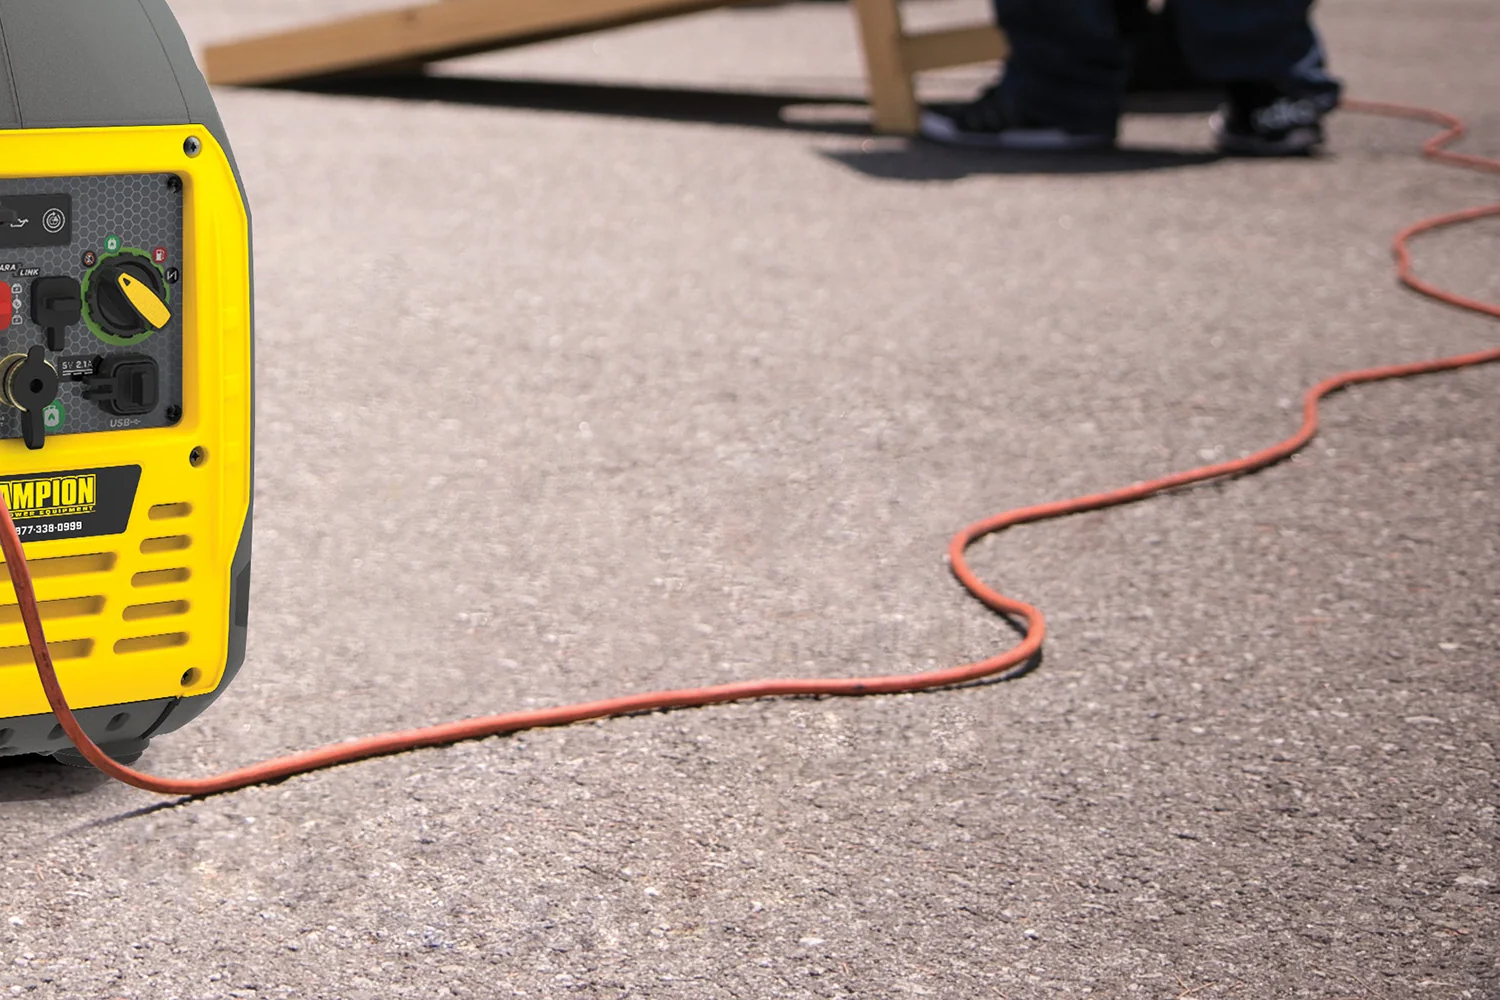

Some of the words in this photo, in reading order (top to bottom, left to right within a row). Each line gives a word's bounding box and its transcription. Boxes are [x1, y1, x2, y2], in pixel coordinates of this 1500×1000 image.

[20, 268, 39, 276] LINK
[109, 418, 130, 428] USB
[39, 506, 94, 516] EQUIPMENT
